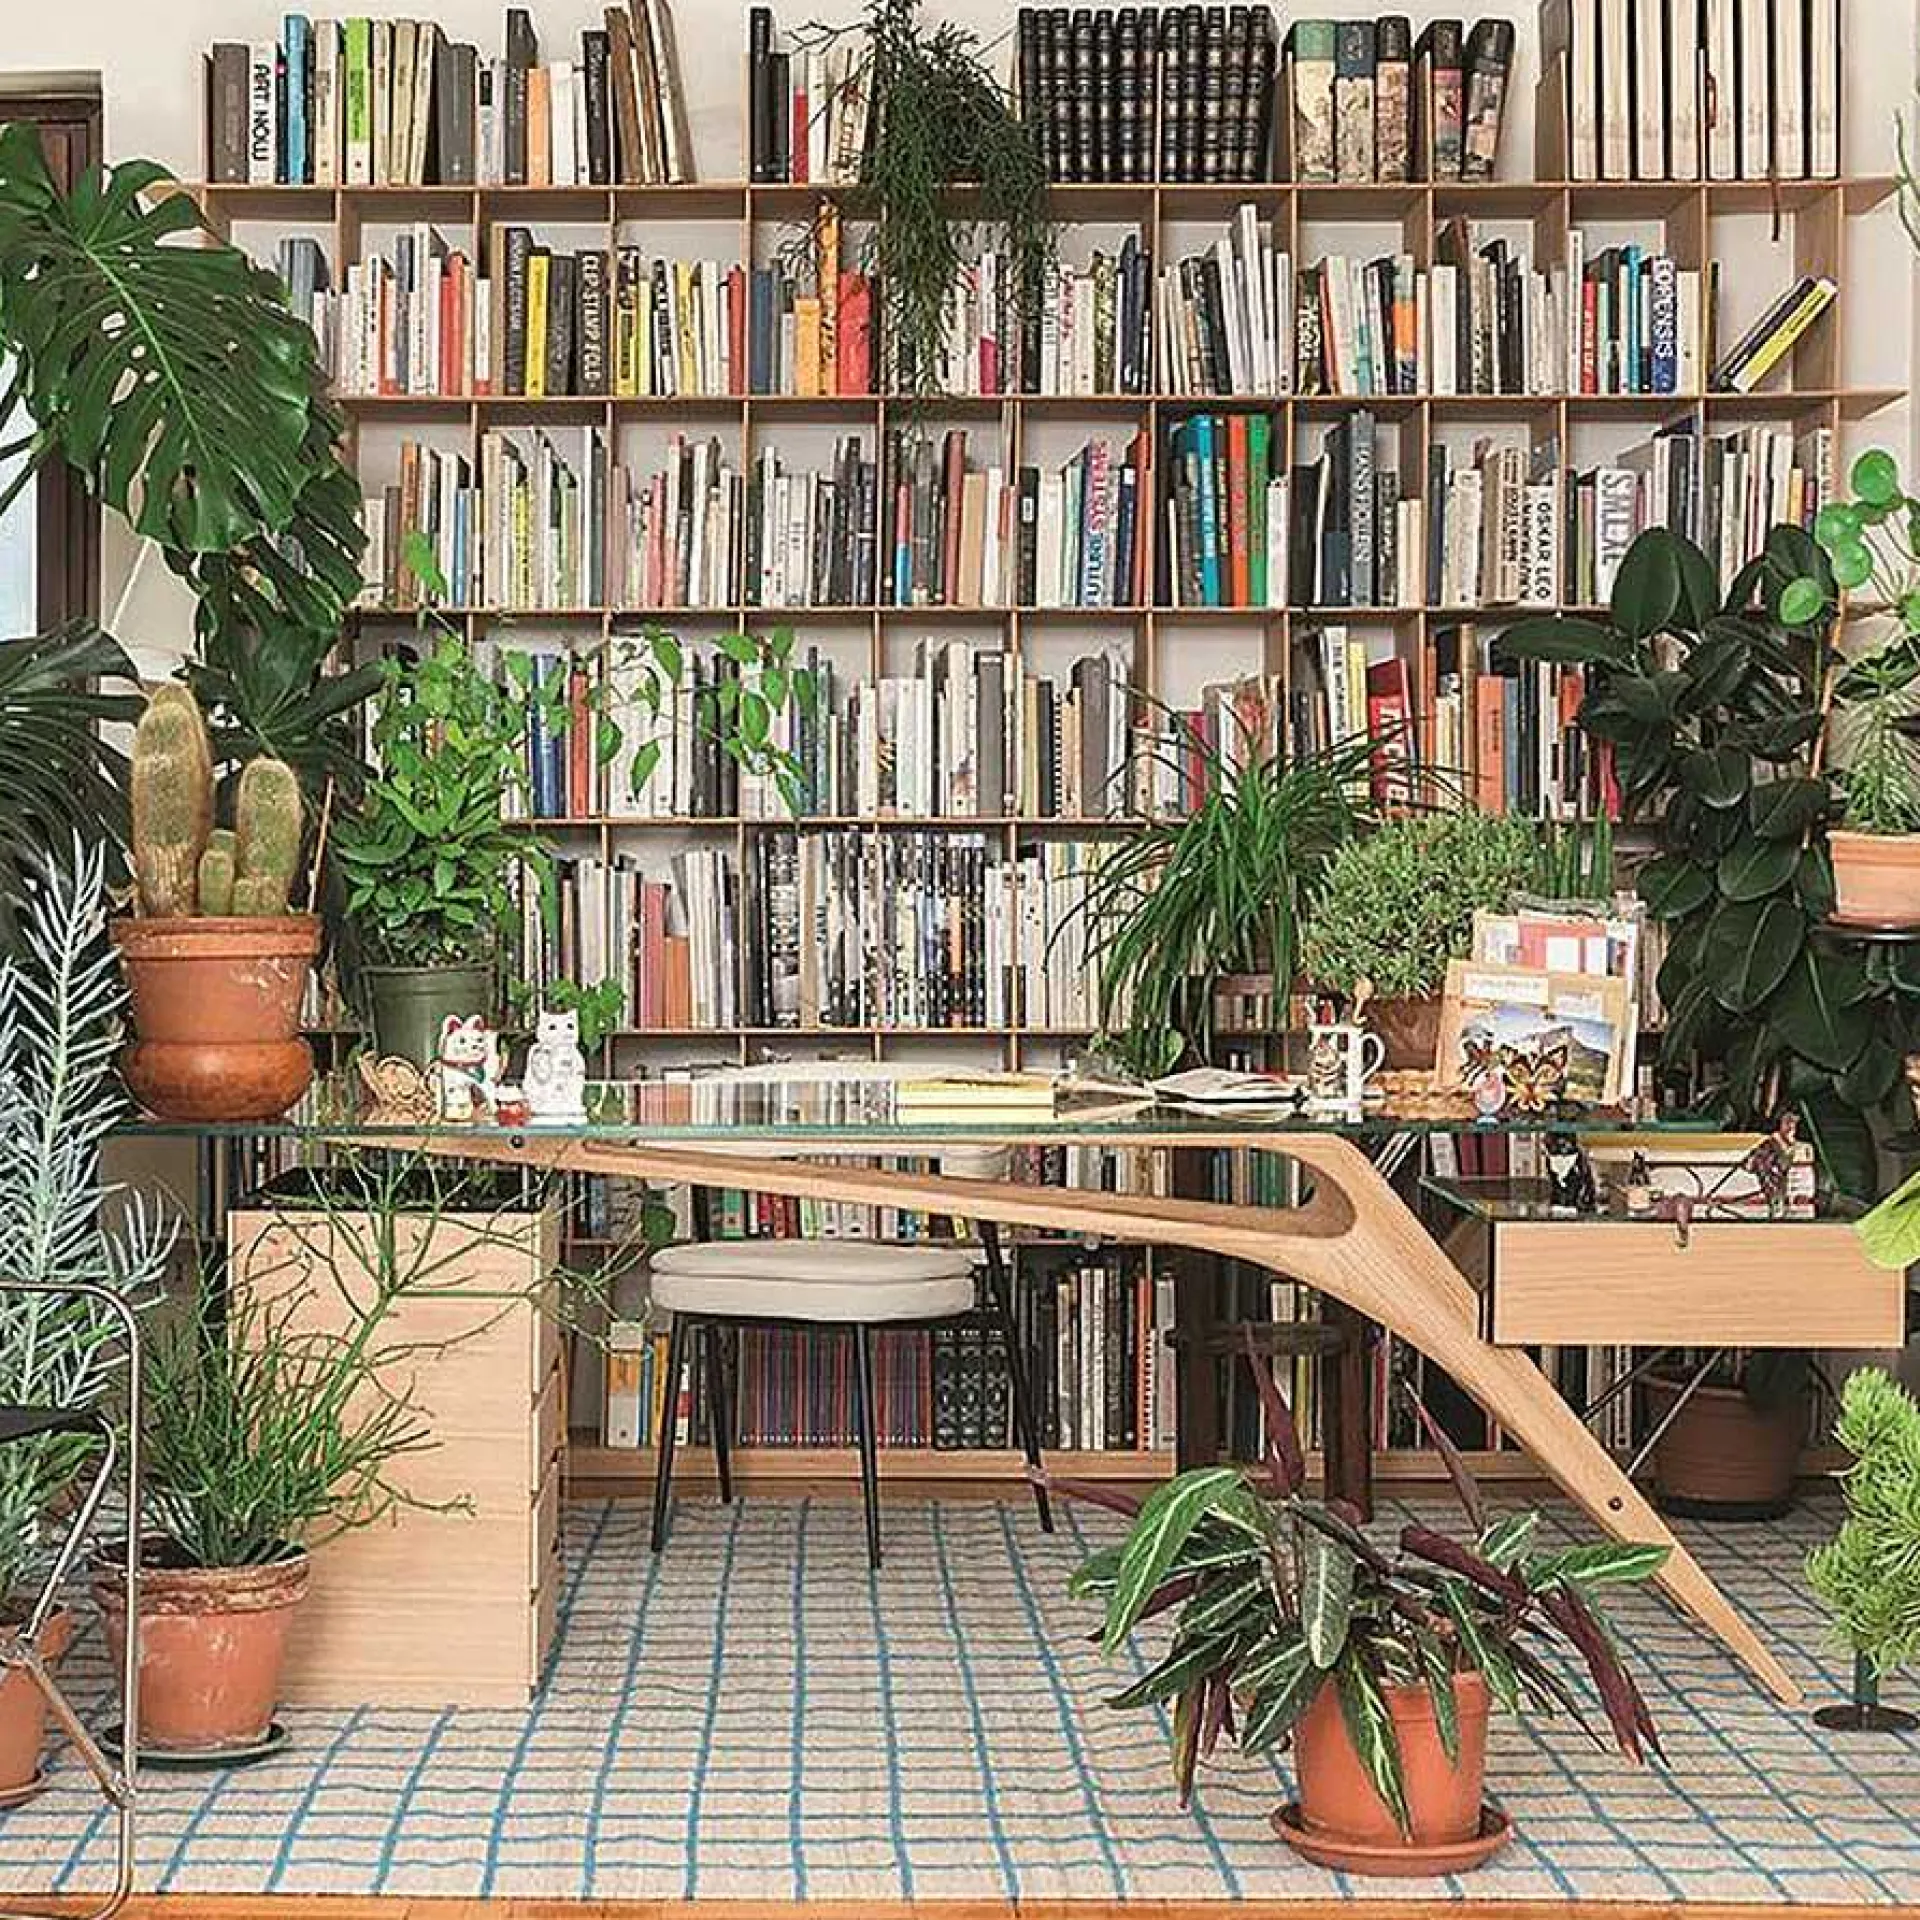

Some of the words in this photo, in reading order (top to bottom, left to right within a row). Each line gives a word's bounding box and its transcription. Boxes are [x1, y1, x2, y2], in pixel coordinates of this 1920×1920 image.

[253, 64, 271, 103] ART
[252, 109, 270, 161] NOW
[1536, 502, 1552, 562] OSKAR
[1536, 567, 1552, 600] LEO
